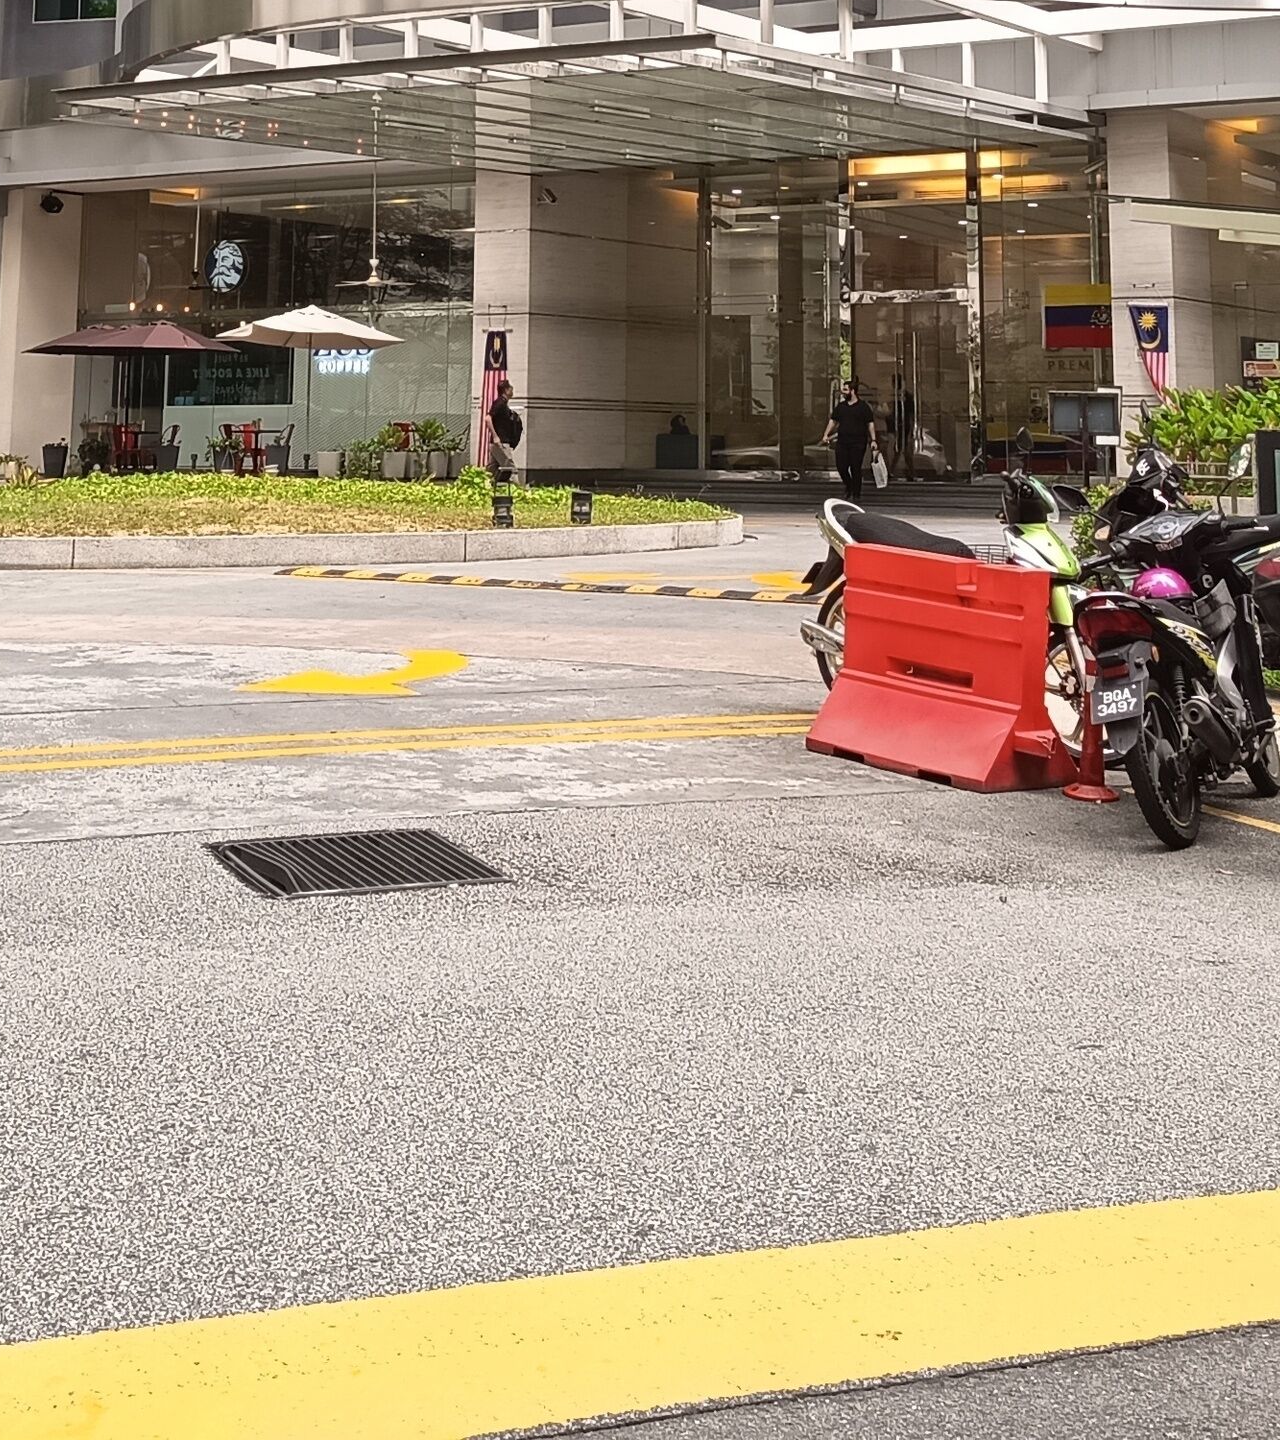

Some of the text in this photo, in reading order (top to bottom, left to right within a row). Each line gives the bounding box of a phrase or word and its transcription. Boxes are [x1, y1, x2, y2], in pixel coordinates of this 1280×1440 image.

[1047, 360, 1091, 372] PREM
[1103, 687, 1132, 704] BQA
[1097, 697, 1137, 717] 3497
